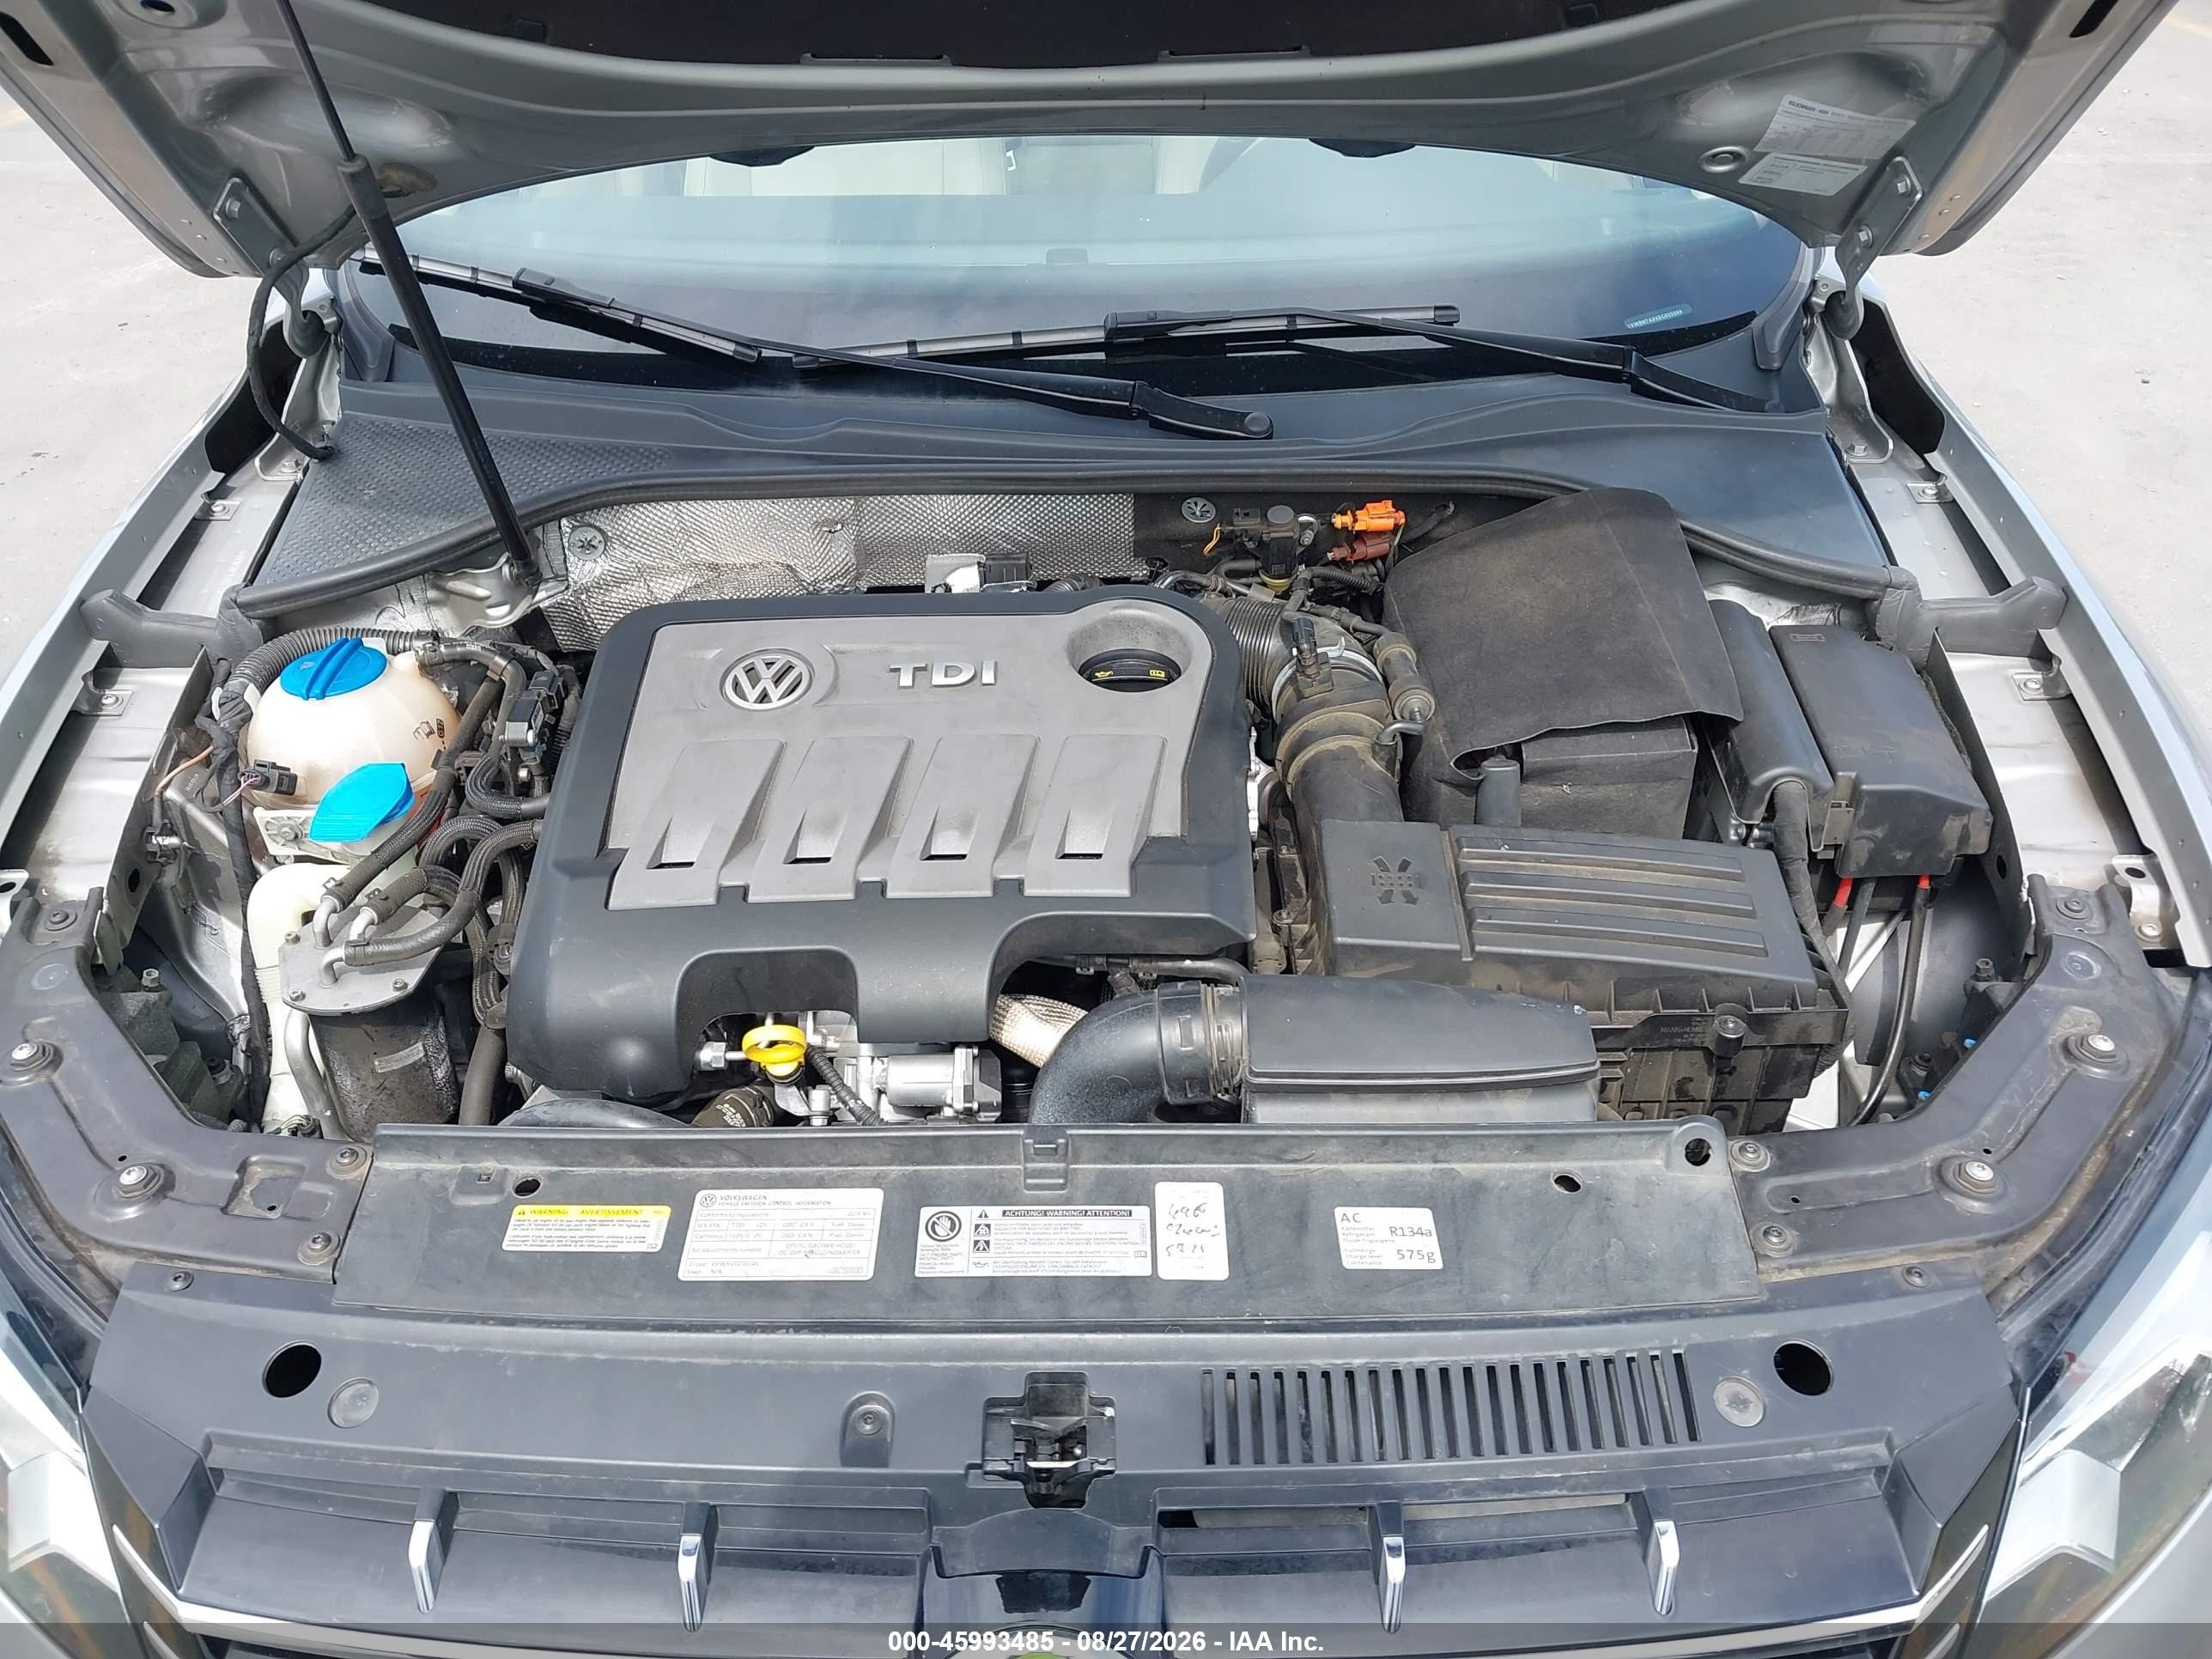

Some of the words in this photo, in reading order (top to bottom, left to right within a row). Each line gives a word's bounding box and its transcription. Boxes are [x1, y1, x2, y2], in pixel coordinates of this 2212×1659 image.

[889, 660, 997, 688] TDI
[1340, 1212, 1361, 1223] AC
[1389, 1226, 1433, 1237] R134a
[1397, 1249, 1437, 1264] 575g
